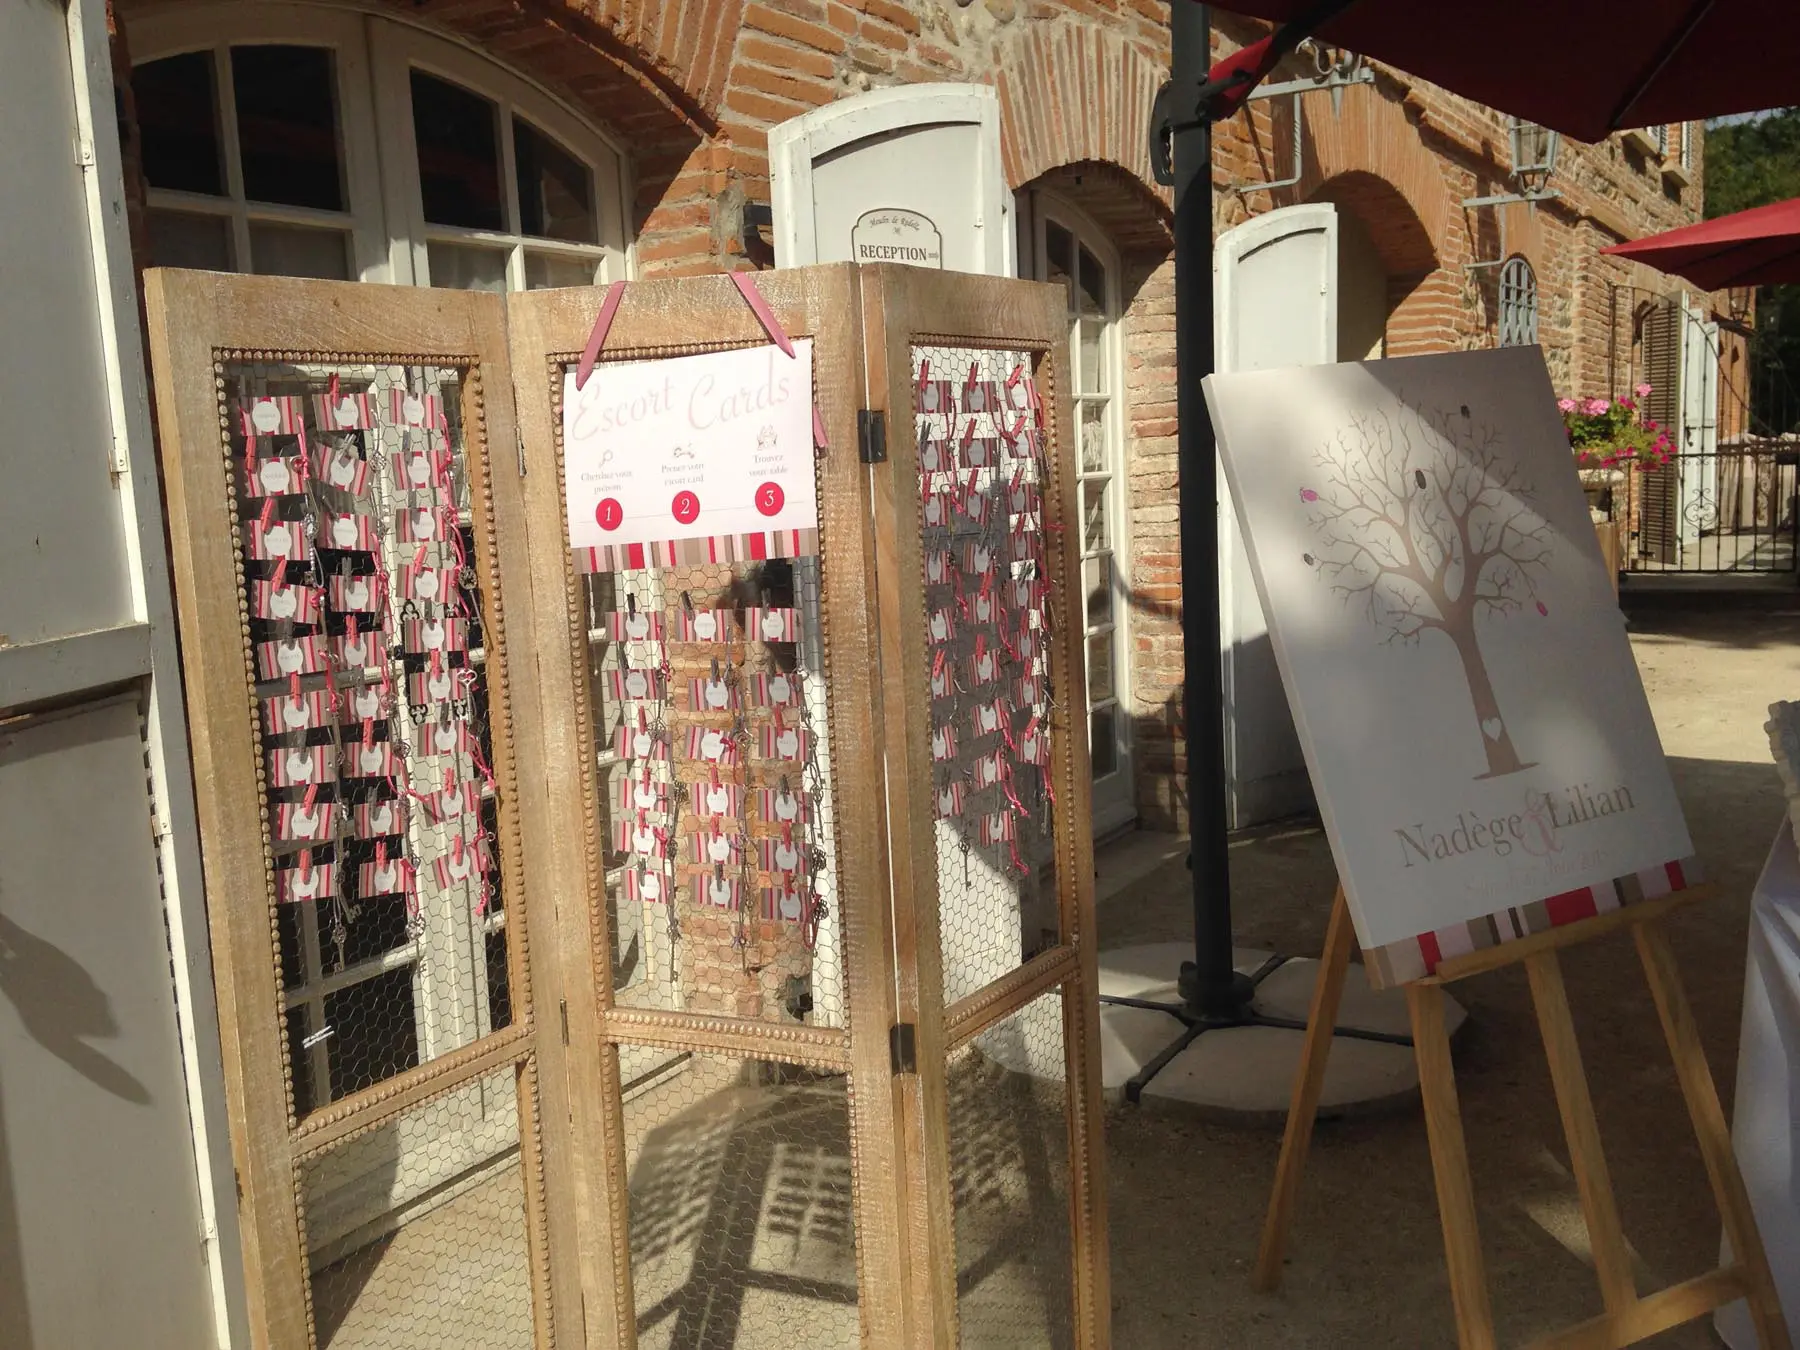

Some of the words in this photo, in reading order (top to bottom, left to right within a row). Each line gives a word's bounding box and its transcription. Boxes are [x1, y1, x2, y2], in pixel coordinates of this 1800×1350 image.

[860, 244, 927, 260] RECEPTION
[571, 375, 677, 441] Escort
[686, 352, 790, 430] Cards
[680, 498, 690, 515] 2
[764, 490, 775, 507] 3
[605, 505, 612, 521] 1
[1394, 810, 1524, 869] Nadège
[1543, 783, 1636, 830] Lilian
